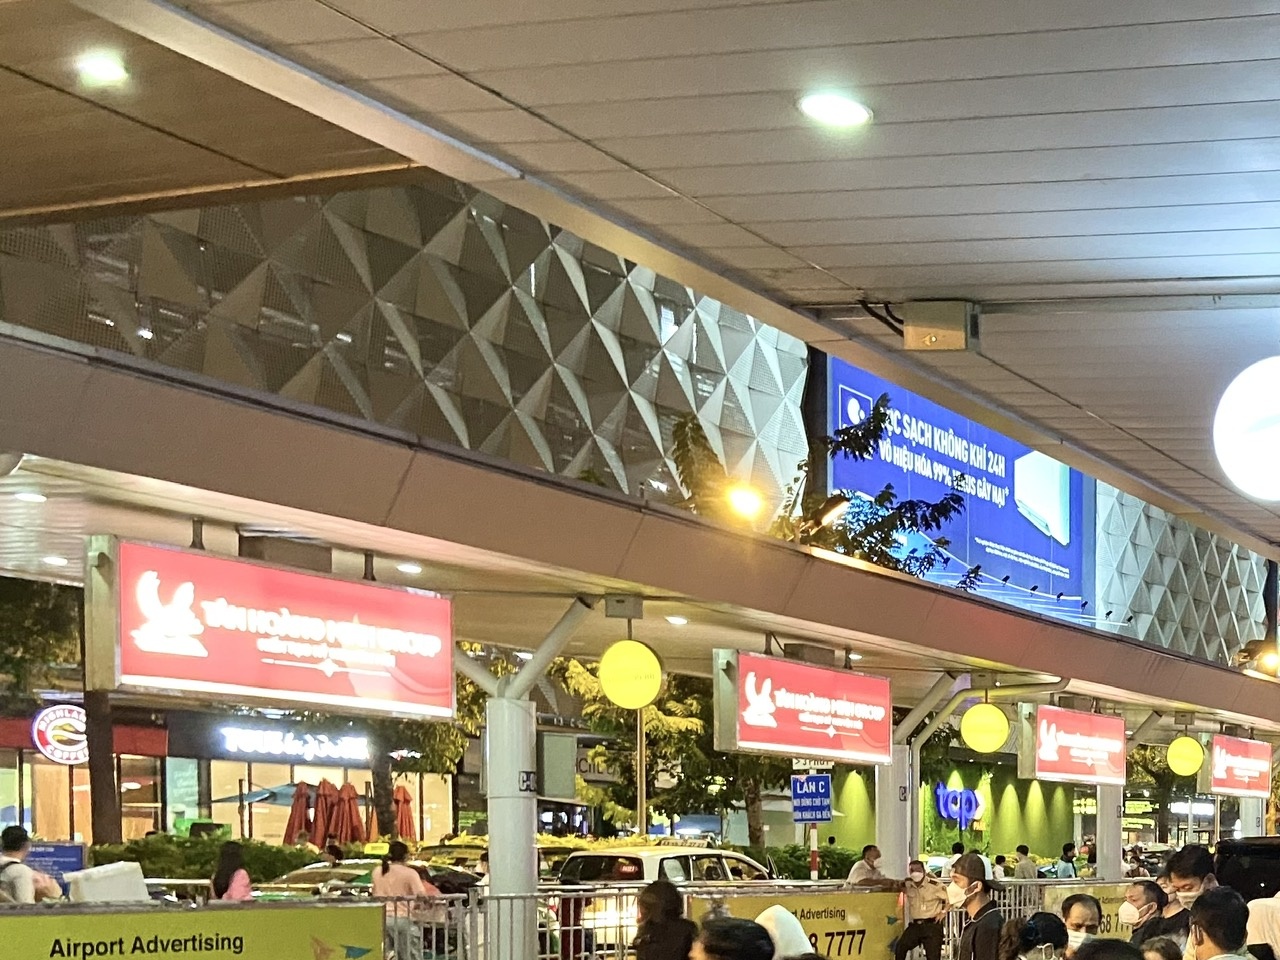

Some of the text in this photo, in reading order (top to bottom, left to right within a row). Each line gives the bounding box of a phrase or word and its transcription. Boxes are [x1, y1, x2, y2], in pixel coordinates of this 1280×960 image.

[902, 414, 933, 448] SẠCH
[933, 427, 969, 464] KHÔNG
[969, 443, 987, 471] KHÍ
[988, 451, 1006, 478] 24H
[878, 438, 893, 463] VÔ
[893, 445, 914, 473] HIỆU
[914, 453, 934, 480] HÓA
[933, 462, 952, 487] 99%
[976, 476, 992, 501] GÂY
[818, 781, 826, 793] C
[800, 907, 846, 921] Advertising
[50, 933, 244, 960] Airport Advertising
[825, 929, 867, 957] 7777
